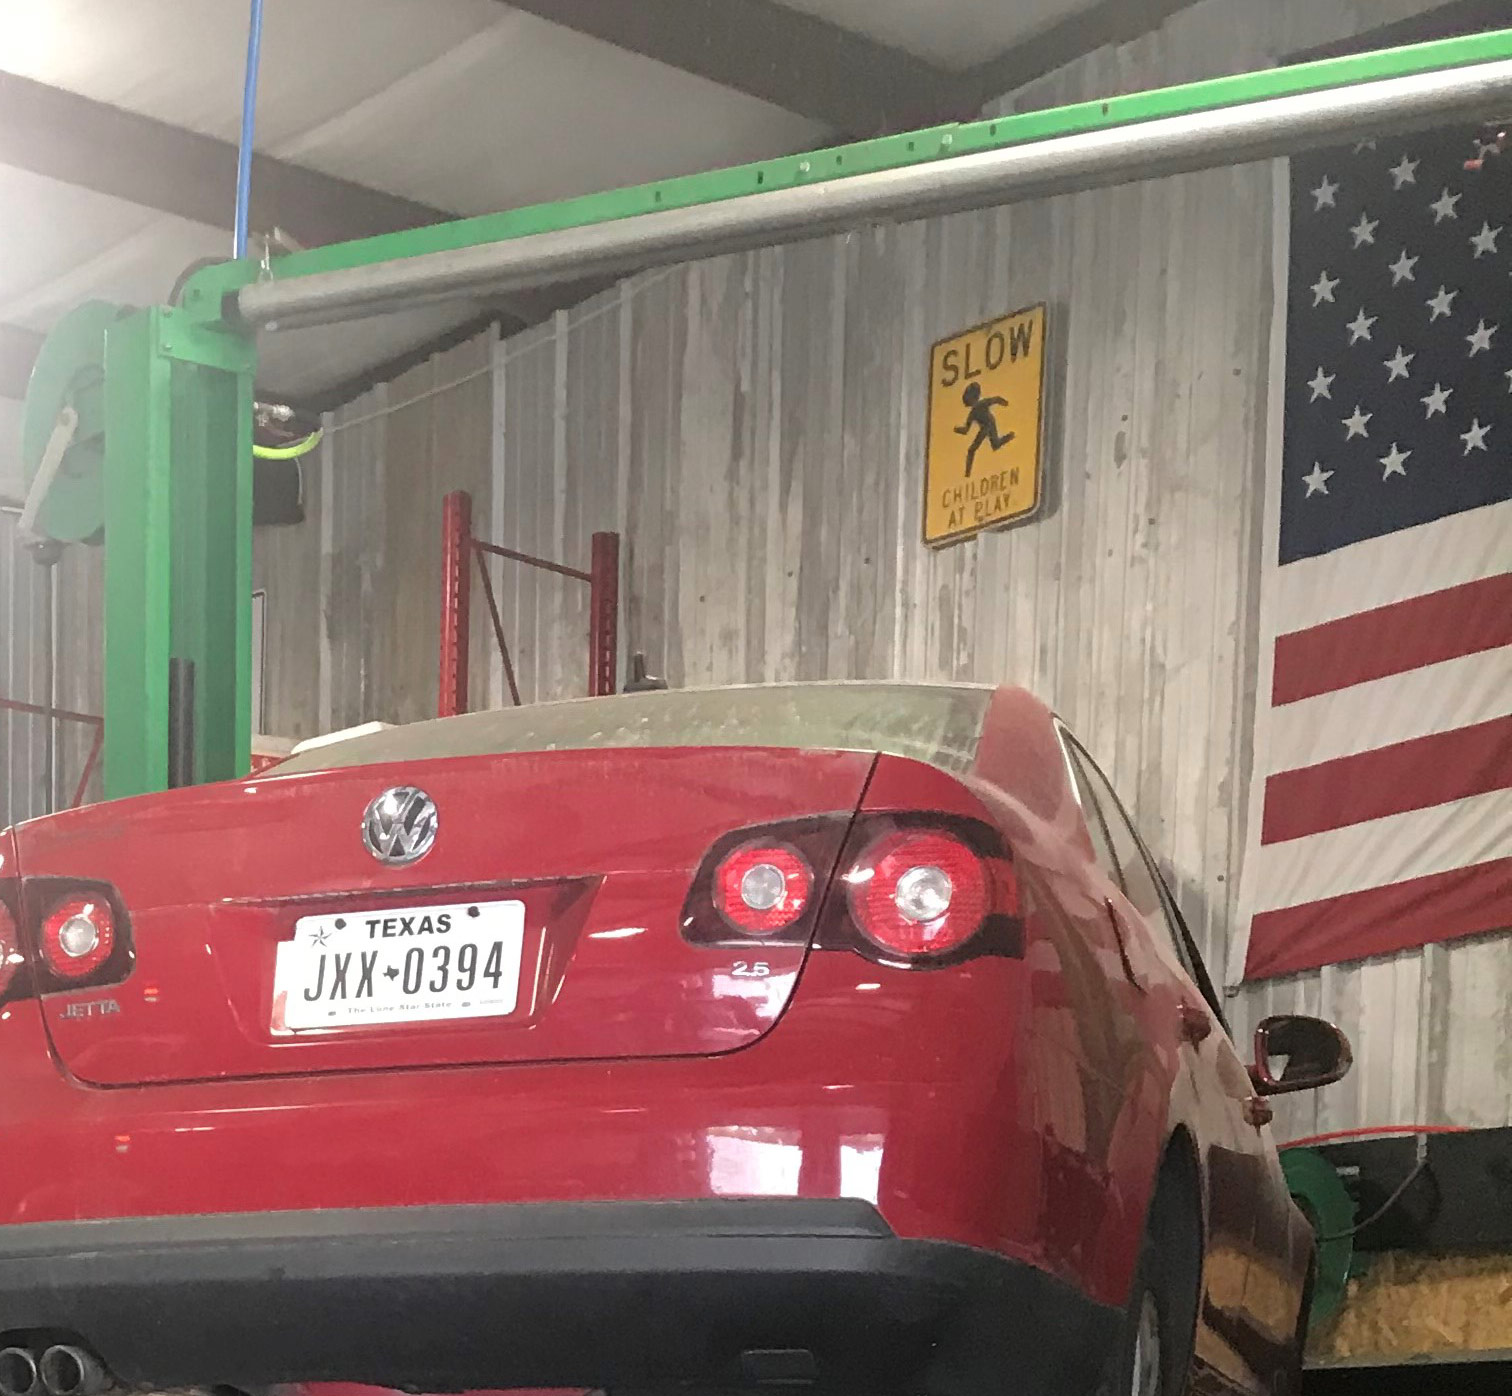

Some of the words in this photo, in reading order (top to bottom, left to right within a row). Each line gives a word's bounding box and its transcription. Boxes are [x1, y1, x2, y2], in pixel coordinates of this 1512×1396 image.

[941, 319, 1033, 388] SLOW
[942, 467, 1020, 509] CHILDREN
[949, 506, 965, 530] AT
[974, 494, 1010, 522] PLAY
[365, 914, 452, 939] TEXAS
[59, 999, 120, 1018] JETTA
